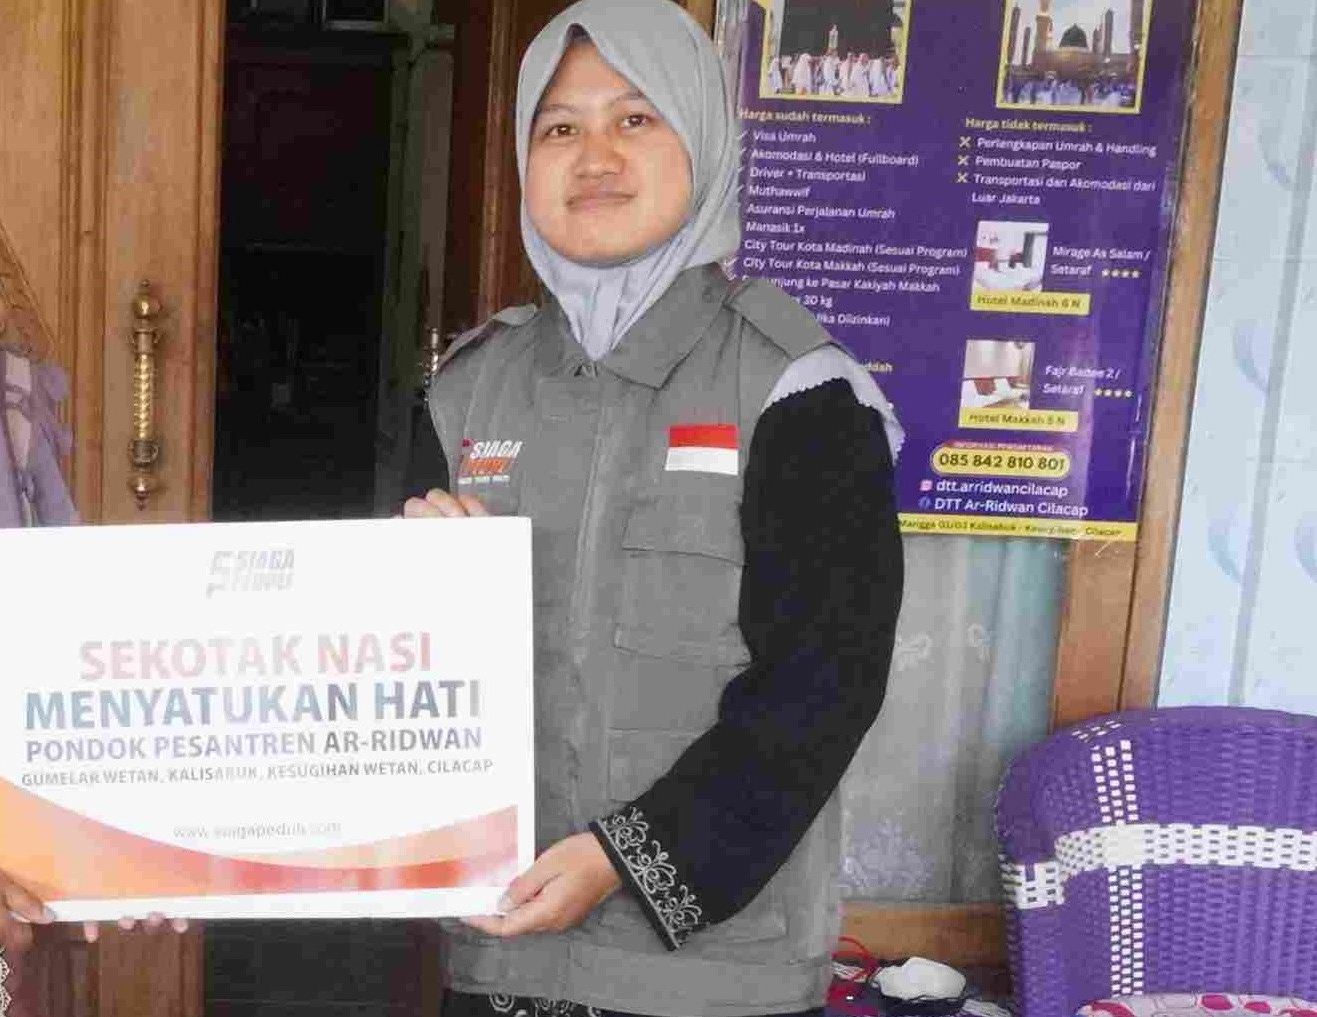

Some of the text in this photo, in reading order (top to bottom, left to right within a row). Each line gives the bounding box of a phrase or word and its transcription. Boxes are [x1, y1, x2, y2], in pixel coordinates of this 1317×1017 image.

[775, 110, 809, 122] sudah
[812, 112, 864, 124] termasuk
[965, 118, 999, 131] Harga
[1001, 118, 1030, 130] tidak
[753, 130, 817, 143] Visa Umrah
[976, 137, 1053, 152] Perlengkapan
[1055, 140, 1093, 153] Umrah
[1106, 143, 1157, 159] Handling
[750, 149, 813, 162] Akomodasi
[825, 151, 856, 164] Hotel
[975, 155, 1082, 171] Pembuatan Paspor
[749, 167, 784, 178] Driver
[796, 169, 866, 182] Transportasi
[973, 173, 1157, 192] Transportasi dan Akomodasi dari
[972, 192, 1041, 205] Luar Jakarta
[747, 203, 896, 220] Asuransi Perjalanan Umrah
[744, 239, 967, 258] City Tour Kota Madinah (Sesuai Program)
[1052, 246, 1091, 261] Mirage
[1092, 248, 1107, 259] As
[1109, 248, 1144, 260] Salam
[743, 257, 961, 276] City Tour Kota Makkah (Sesuai Program)
[1050, 264, 1093, 277] Setaraf
[806, 278, 819, 288] ke
[821, 278, 851, 290] Pasar
[898, 280, 941, 293] Makkah
[803, 294, 818, 305] 30
[820, 295, 833, 308] kg
[938, 451, 1066, 470] 085 842 810 801
[934, 497, 1089, 518] DTT Ar-Ridwan Cilacap
[79, 631, 431, 681] SEKOTAK NASI
[24, 679, 482, 730] MENYATUKAN HATI
[25, 726, 483, 763] PONDOK PESANTREN AR-RIDWAN
[22, 771, 101, 787] GUMELAR
[102, 769, 165, 785] WETAN,
[267, 763, 360, 780] KESUGIHAN
[363, 760, 425, 778] WETAN,
[427, 758, 494, 775] CILACAP
